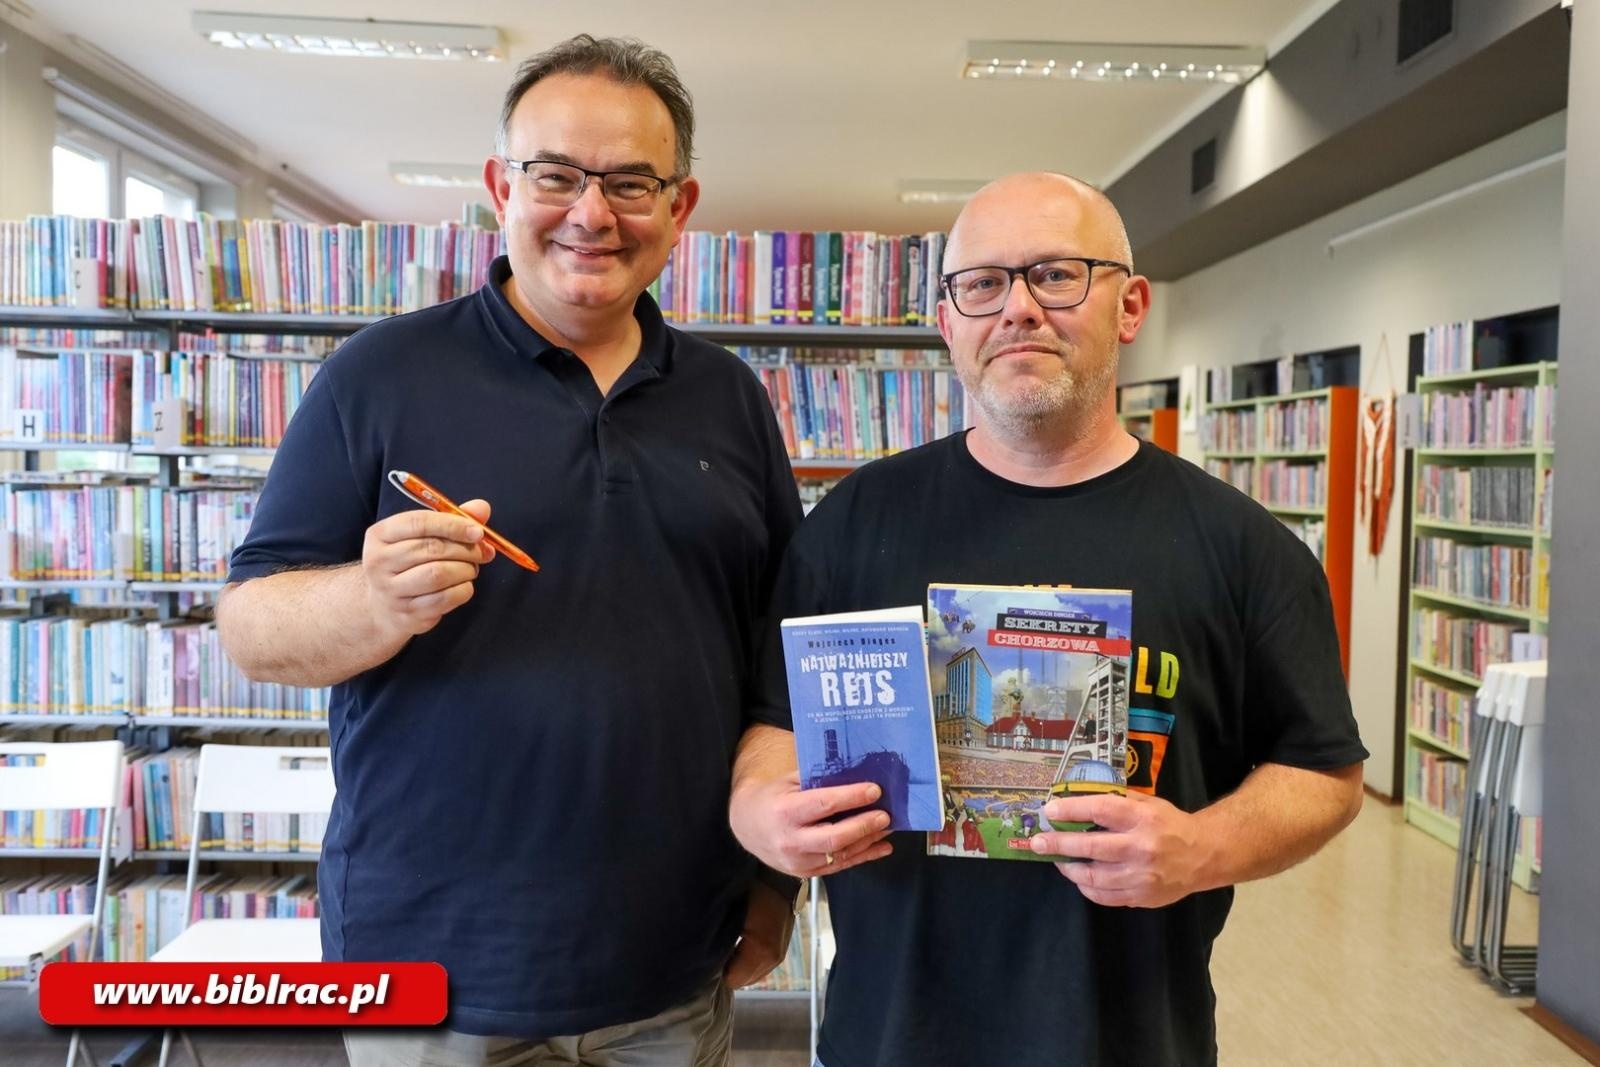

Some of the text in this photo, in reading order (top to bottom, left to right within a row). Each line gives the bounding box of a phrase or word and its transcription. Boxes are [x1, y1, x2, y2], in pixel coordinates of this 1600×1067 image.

[22, 415, 36, 437] H
[1004, 616, 1100, 635] SEKRETY
[994, 632, 1100, 652] CHORZOWA
[1135, 646, 1180, 699] LD
[820, 669, 896, 708] REJS
